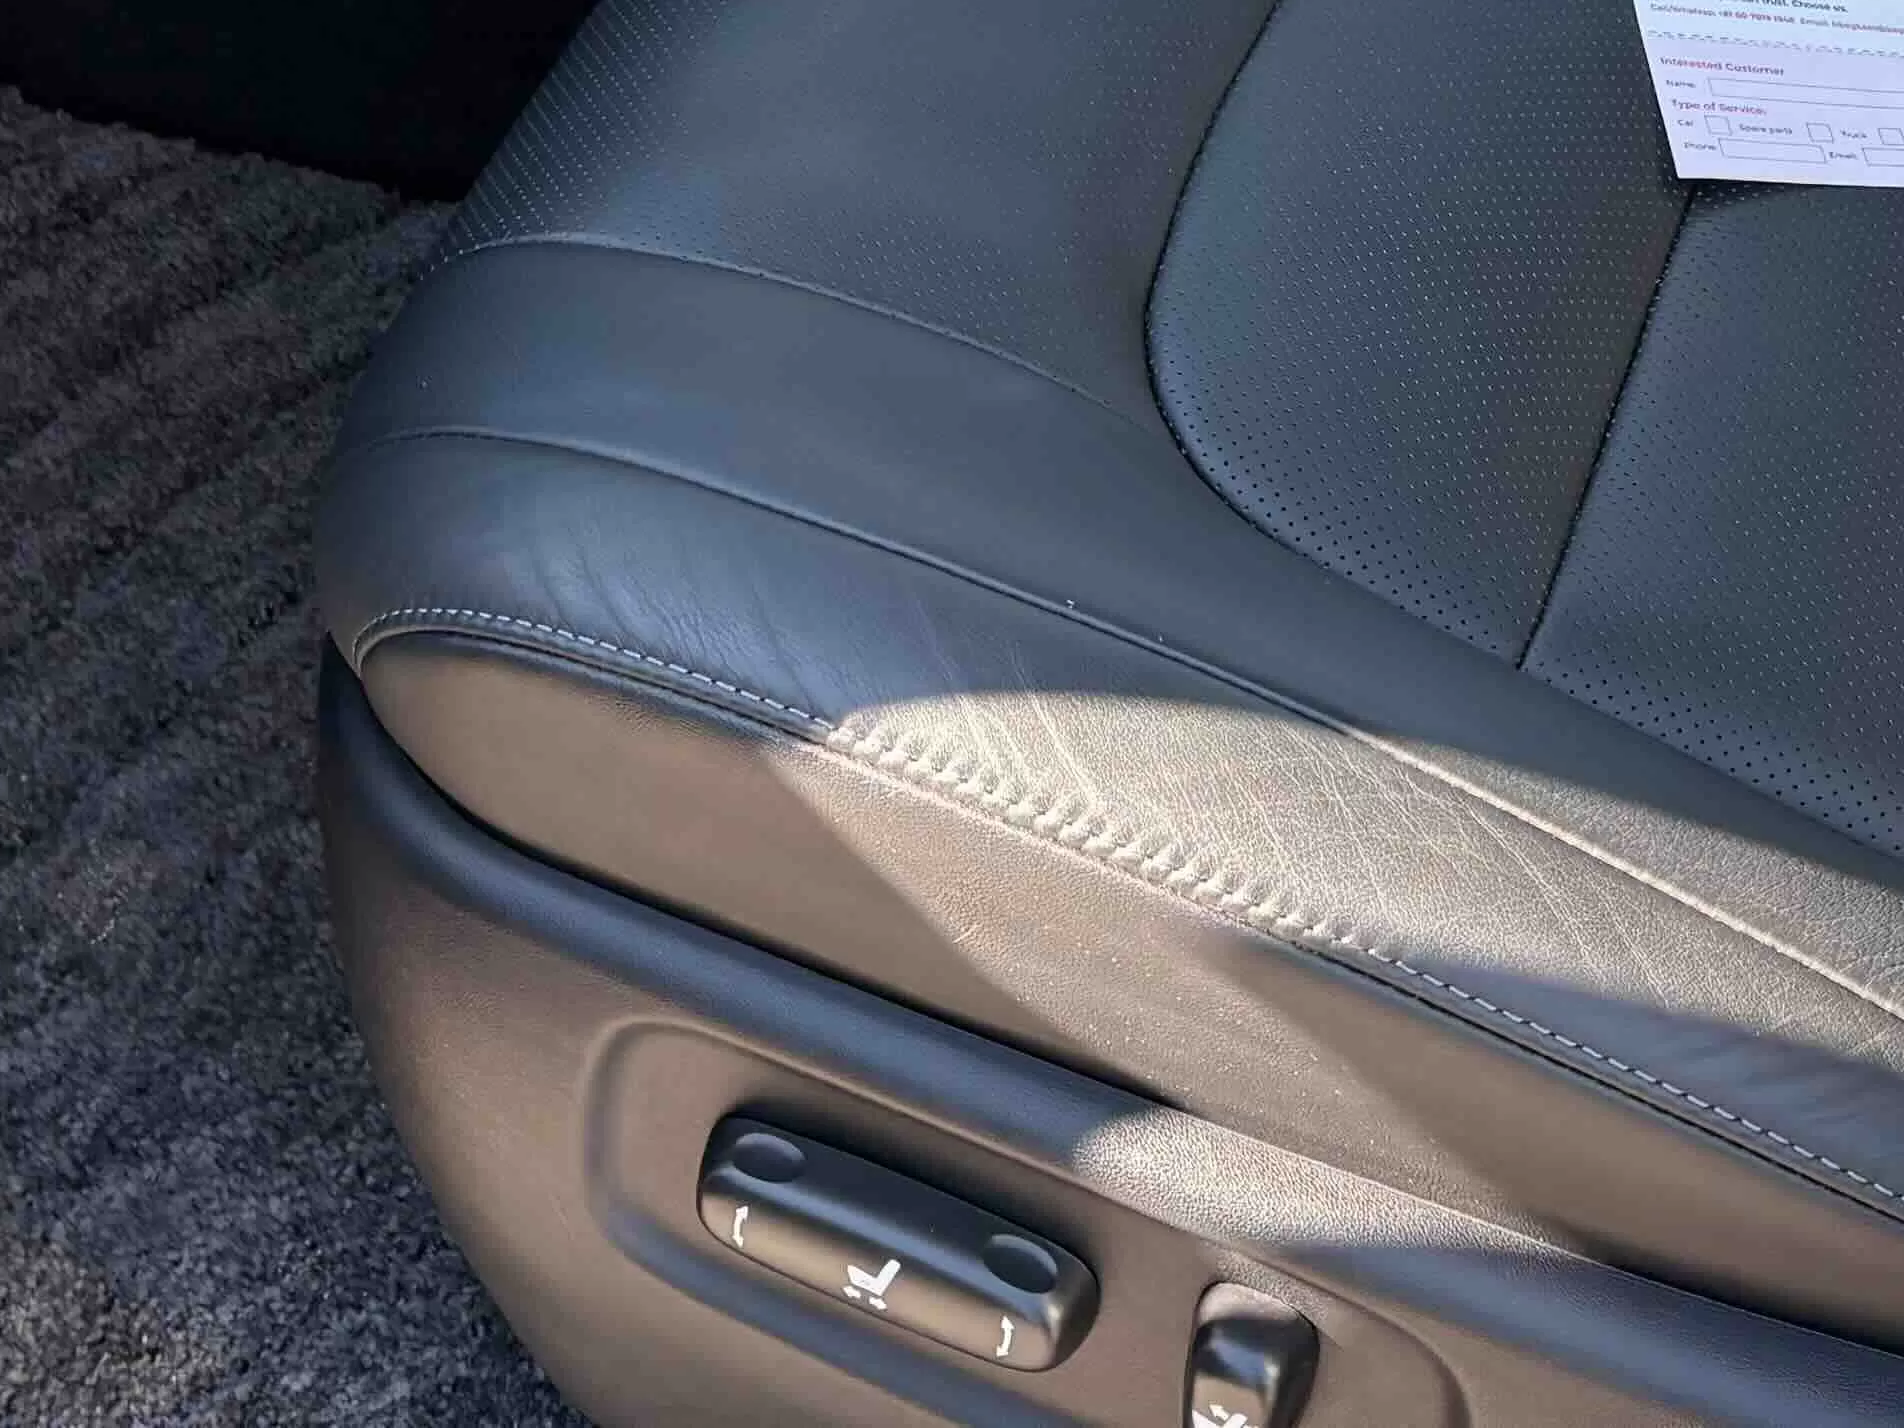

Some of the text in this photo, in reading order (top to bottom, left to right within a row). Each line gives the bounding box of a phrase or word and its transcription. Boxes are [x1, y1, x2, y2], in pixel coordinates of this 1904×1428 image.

[1791, 0, 1832, 12] Choose
[1659, 56, 1785, 77] Interested Customer
[1671, 97, 1701, 112] Type
[1703, 100, 1716, 111] of
